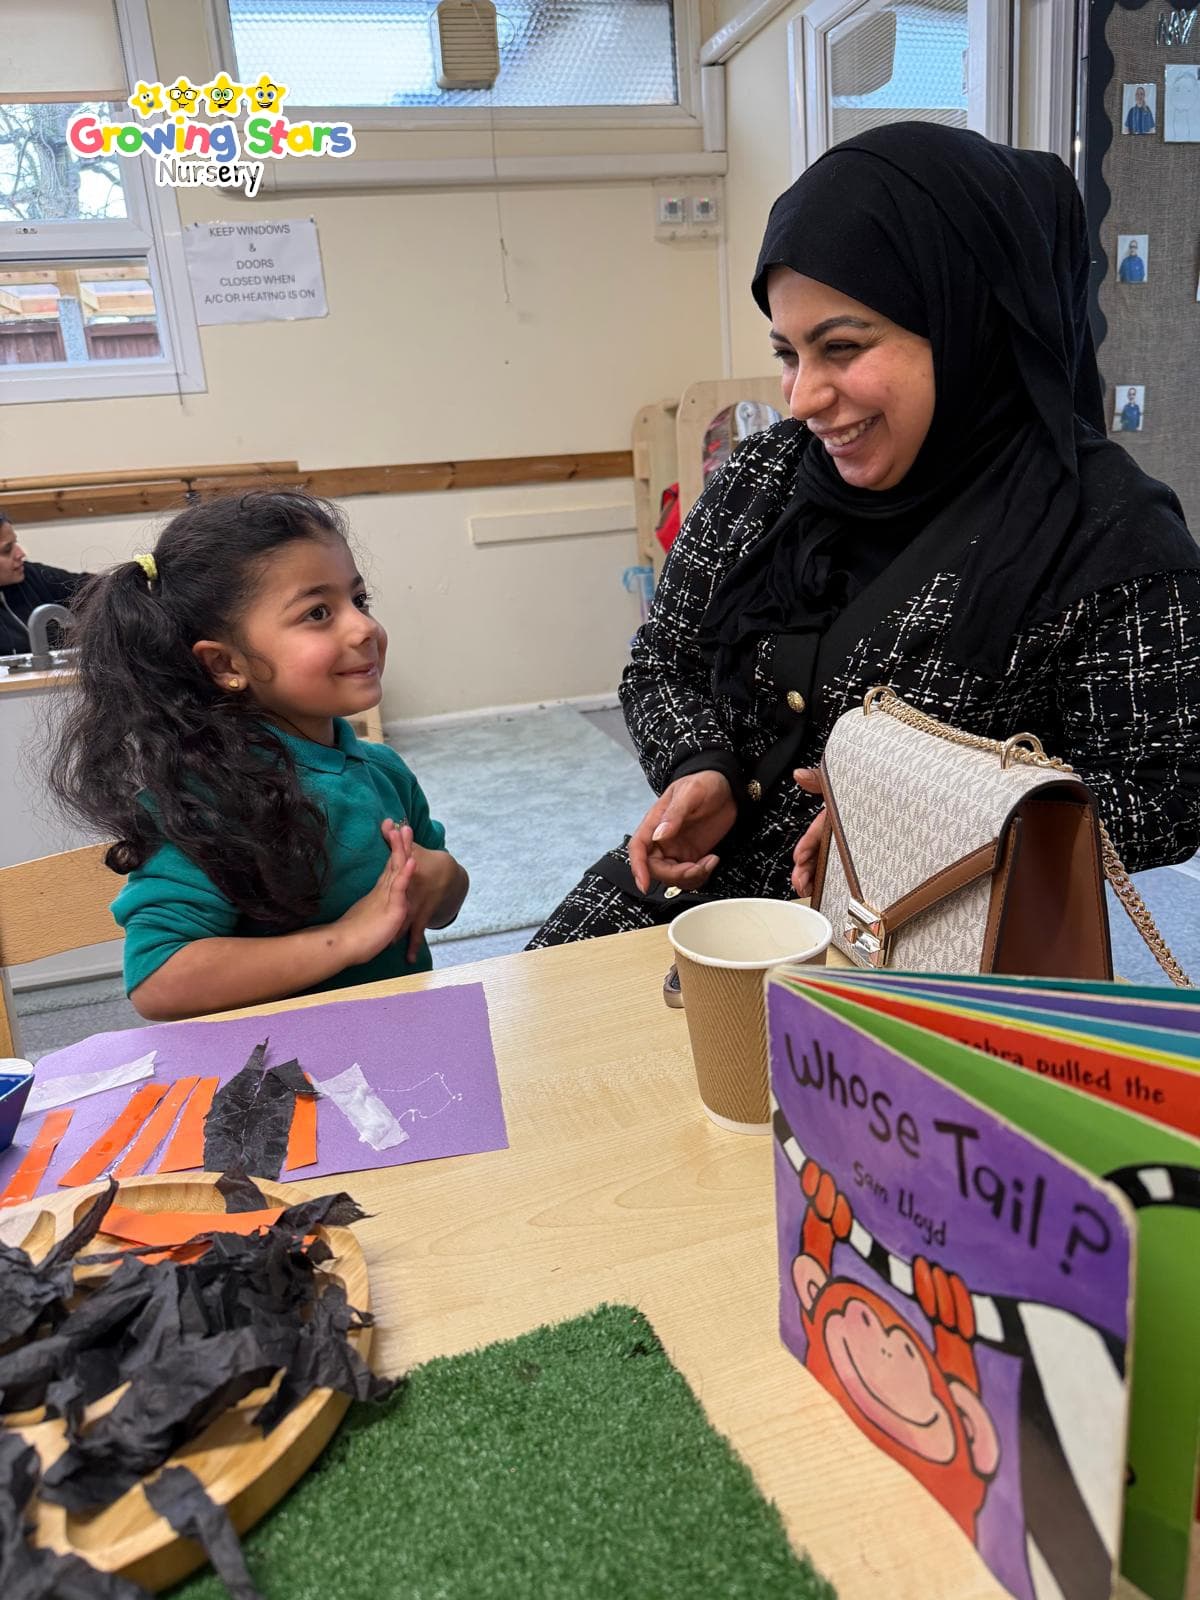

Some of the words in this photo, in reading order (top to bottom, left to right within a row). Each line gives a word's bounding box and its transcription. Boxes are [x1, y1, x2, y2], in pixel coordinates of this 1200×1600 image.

[209, 226, 235, 237] KEEP
[236, 224, 291, 236] WINDOWS
[248, 243, 257, 253] &
[236, 259, 275, 270] DOORS
[220, 276, 262, 287] CLOSED
[263, 274, 296, 285] WHEN
[204, 294, 224, 304] A/C
[224, 293, 240, 304] OR
[242, 291, 287, 302] HEATING
[288, 290, 298, 300] IS
[299, 289, 316, 299] ON
[1036, 1058, 1111, 1092] pulled
[1125, 1076, 1165, 1104] the
[785, 1032, 921, 1159] Whose
[853, 1161, 889, 1204] Sam
[898, 1189, 947, 1248] Lloyd
